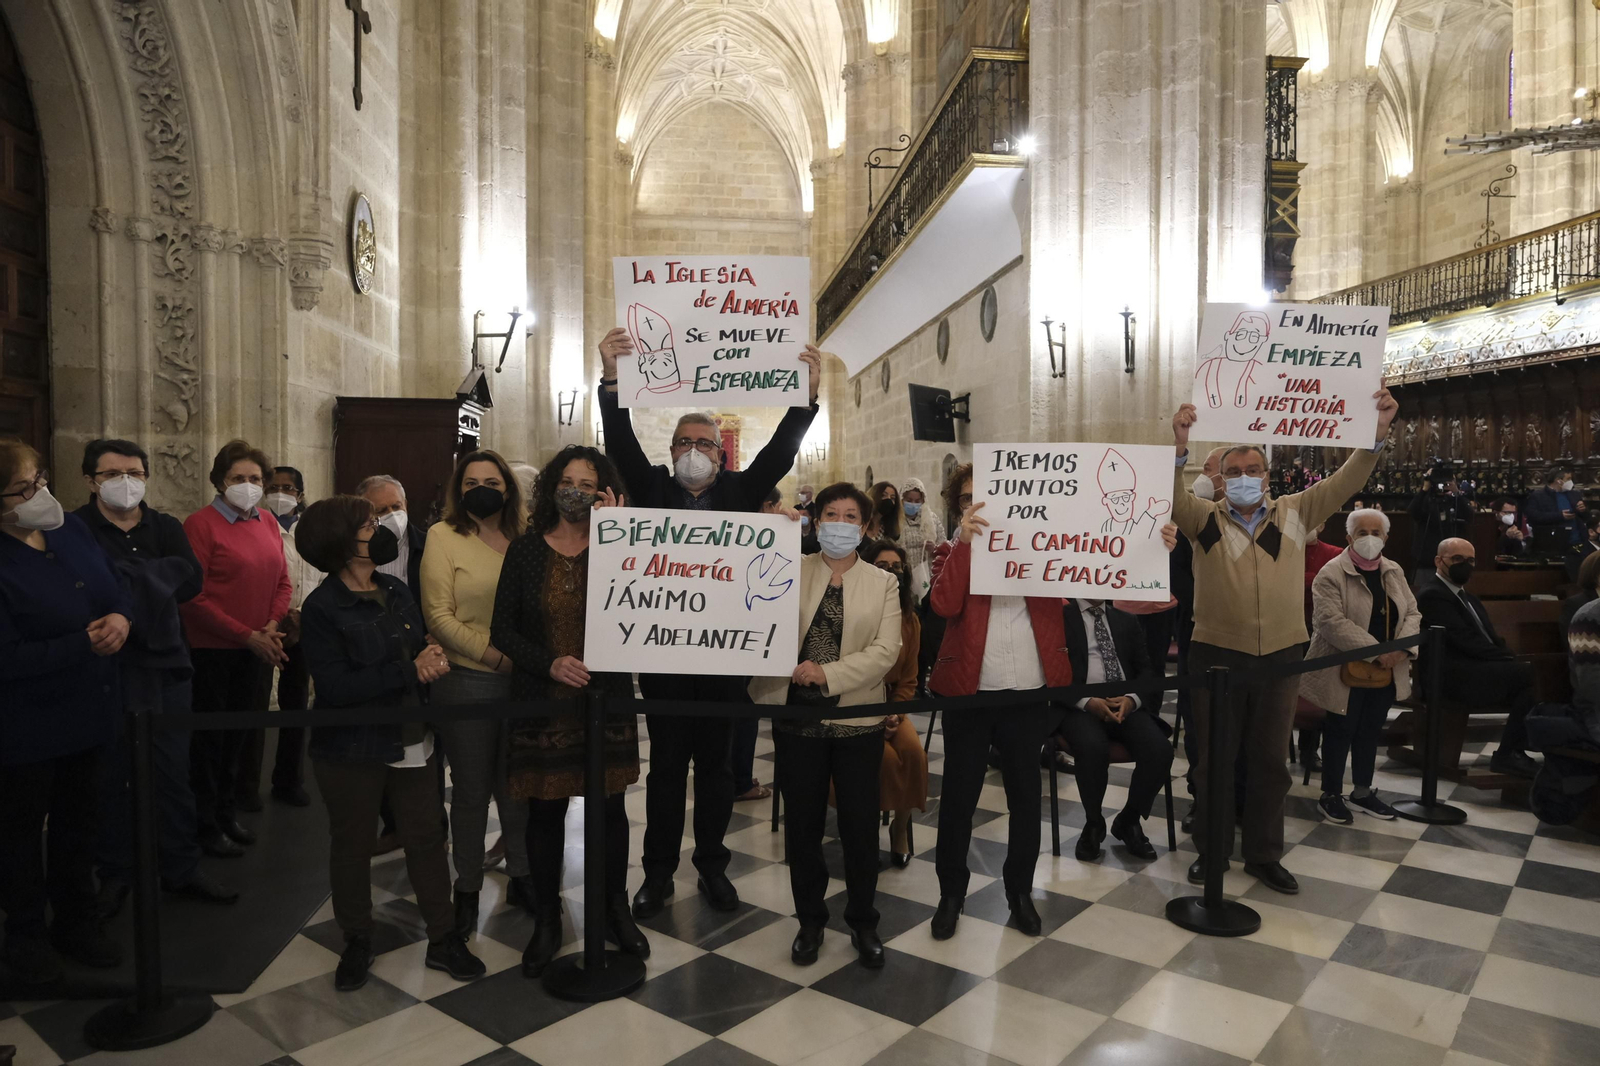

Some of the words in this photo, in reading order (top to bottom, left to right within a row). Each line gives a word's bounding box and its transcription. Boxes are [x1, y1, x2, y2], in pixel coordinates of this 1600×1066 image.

[694, 289, 717, 308] de
[719, 328, 795, 343] MUEVE
[1306, 314, 1379, 336] Almería
[693, 366, 799, 393] ESPERANZA
[1248, 417, 1267, 431] de
[991, 450, 1077, 473] IREMOS
[988, 479, 1078, 496] JUNTOS
[1007, 505, 1048, 521] POR
[989, 530, 1019, 552] EL
[622, 557, 636, 570] a
[643, 554, 734, 582] Almería
[1005, 561, 1033, 579] DE
[1043, 559, 1127, 589] EMAÚS
[619, 622, 635, 645] Y
[643, 624, 776, 658] ADELANTE!
